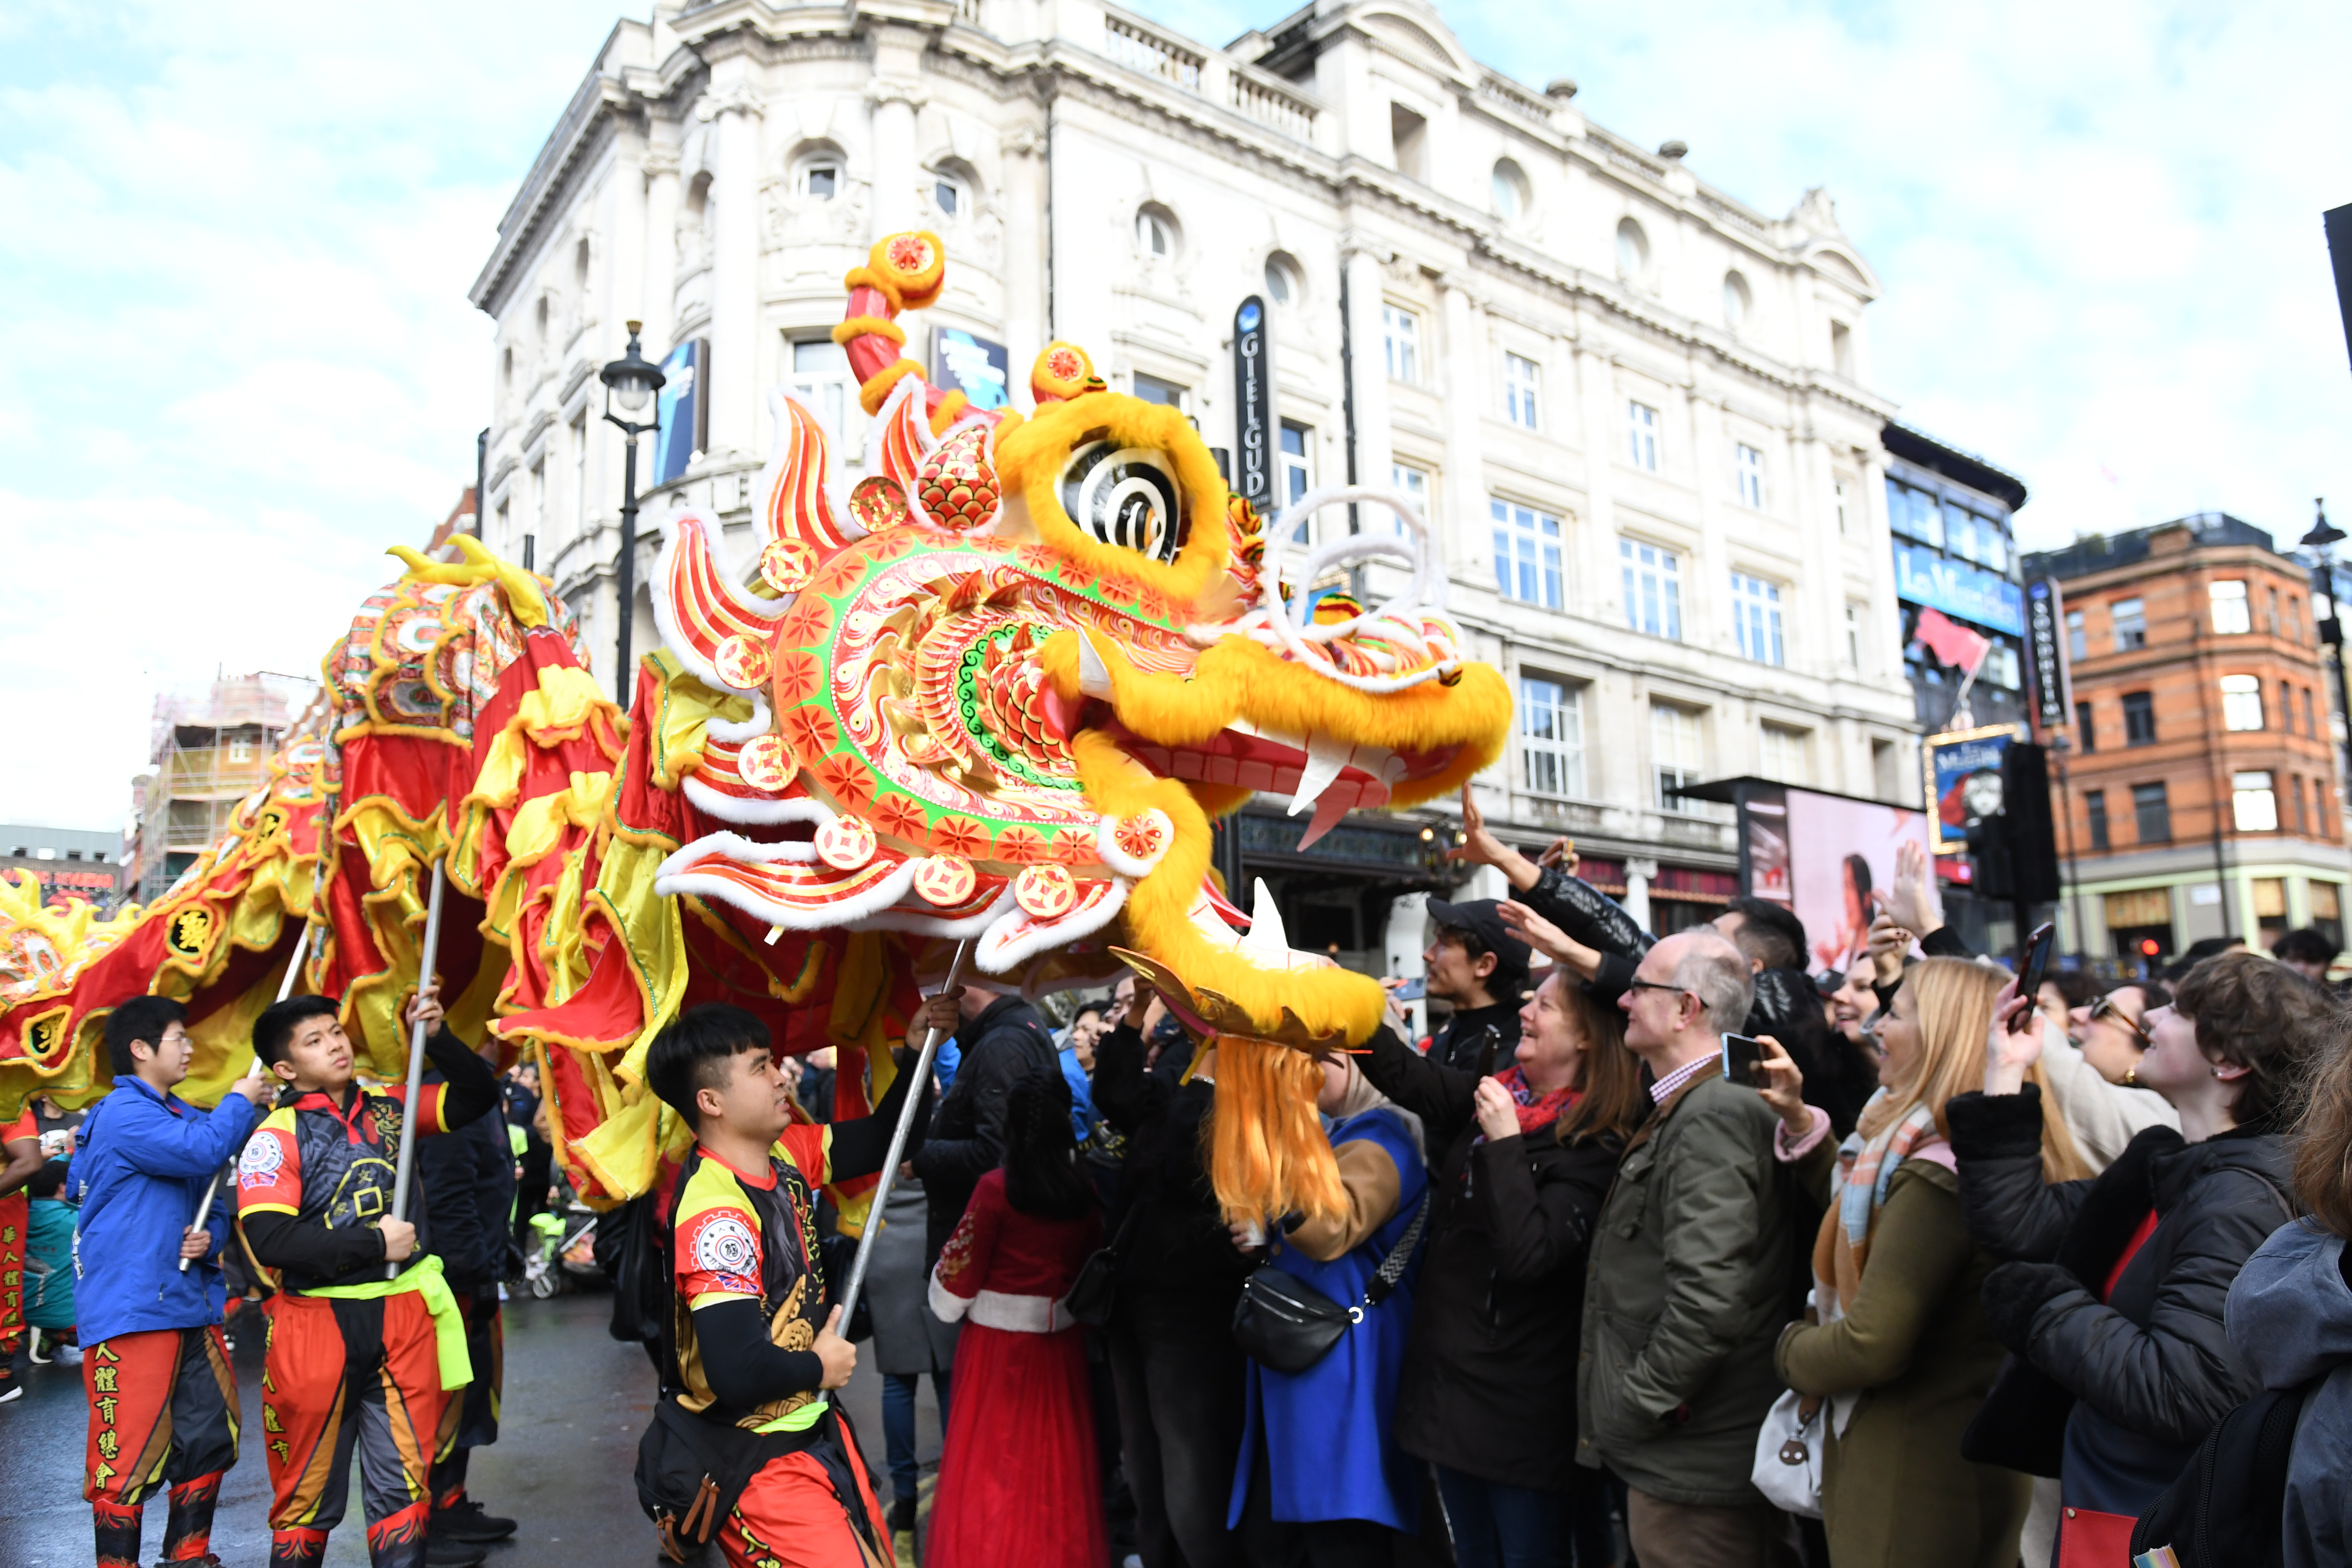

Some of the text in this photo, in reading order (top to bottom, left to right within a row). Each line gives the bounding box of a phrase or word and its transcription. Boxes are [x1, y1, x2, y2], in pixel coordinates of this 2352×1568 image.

[1241, 332, 1264, 497] GIELGUD
[94, 1342, 120, 1489] 人體育總會
